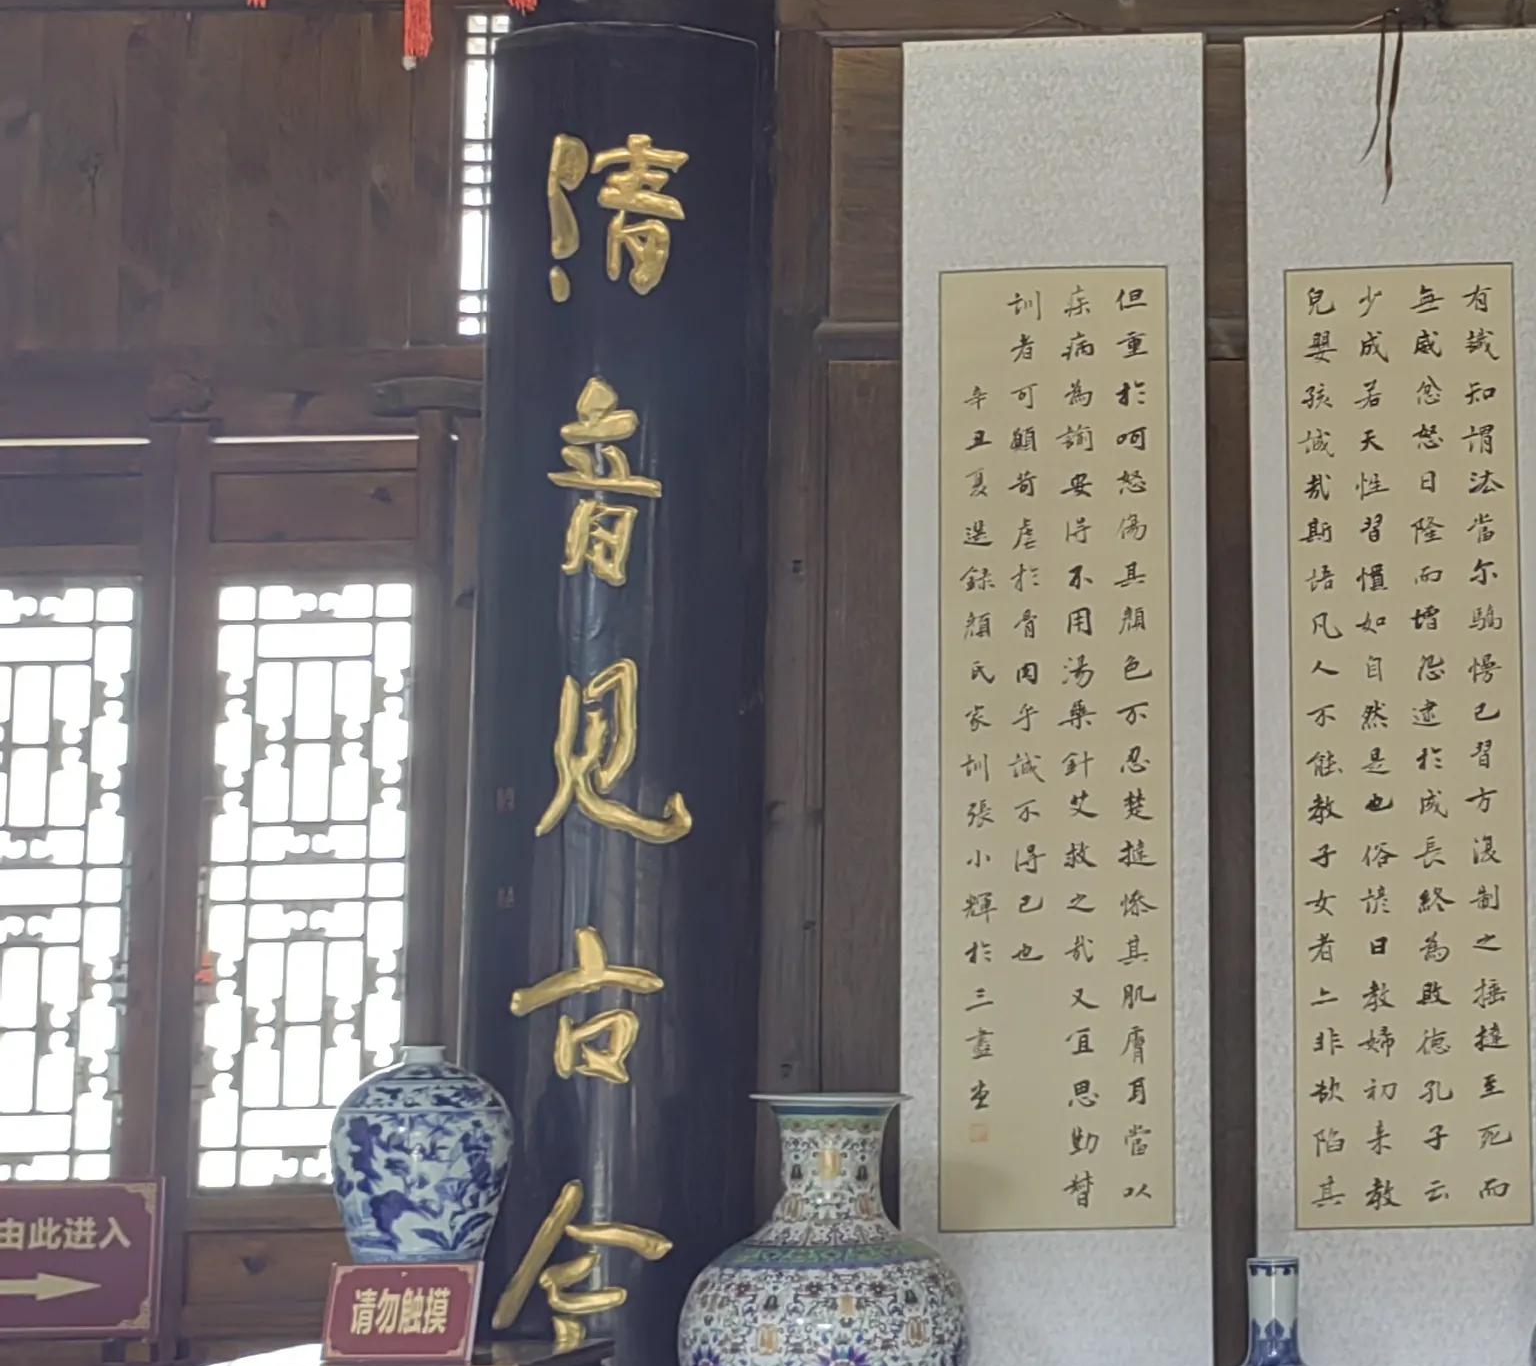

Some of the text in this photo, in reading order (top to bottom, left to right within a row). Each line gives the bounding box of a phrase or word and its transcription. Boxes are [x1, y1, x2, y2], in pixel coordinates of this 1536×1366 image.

[0, 1216, 131, 1250] 由此进入
[350, 1287, 451, 1335] 请勿触摸
